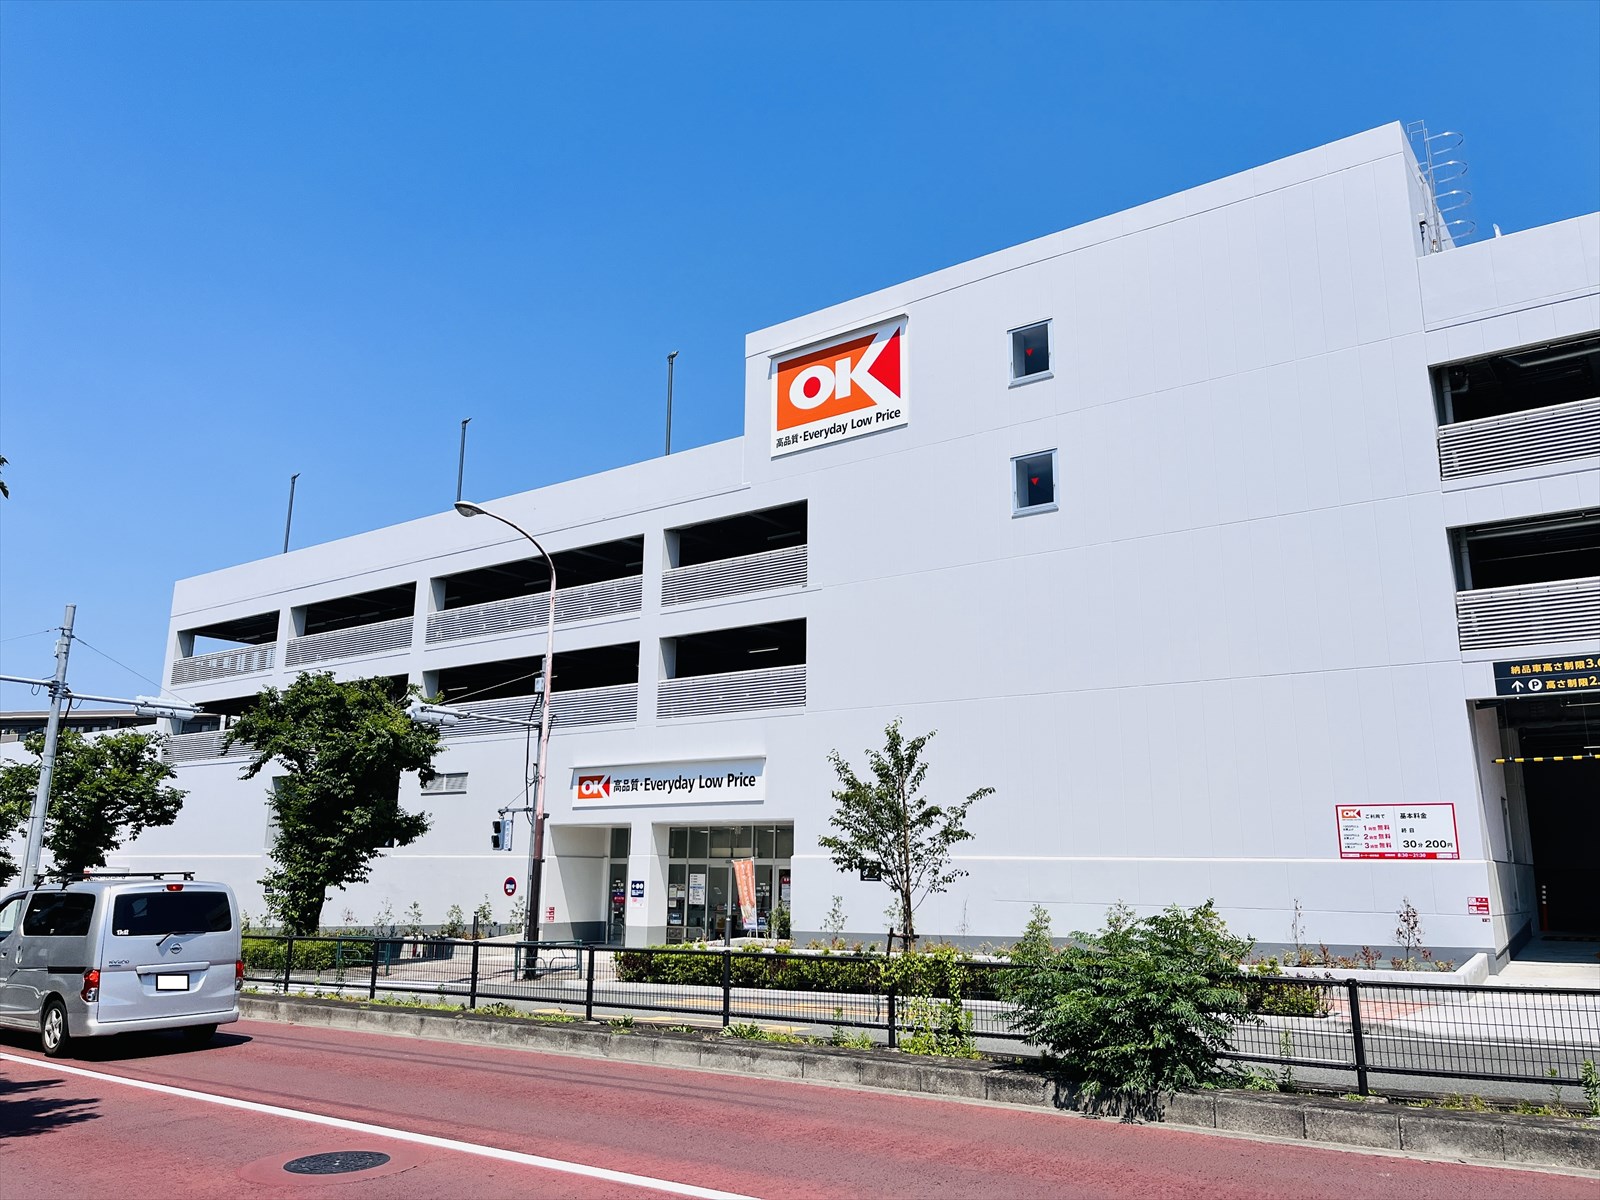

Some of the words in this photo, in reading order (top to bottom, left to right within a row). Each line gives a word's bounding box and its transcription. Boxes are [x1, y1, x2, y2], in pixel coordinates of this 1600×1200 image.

[788, 328, 899, 410] OK
[851, 416, 873, 429] Low
[875, 409, 901, 423] Price
[1511, 659, 1600, 674] 納品車高さ制限3.
[580, 774, 610, 798] OK
[699, 774, 724, 789] Low
[727, 772, 756, 788] Price
[1342, 809, 1361, 819] OK
